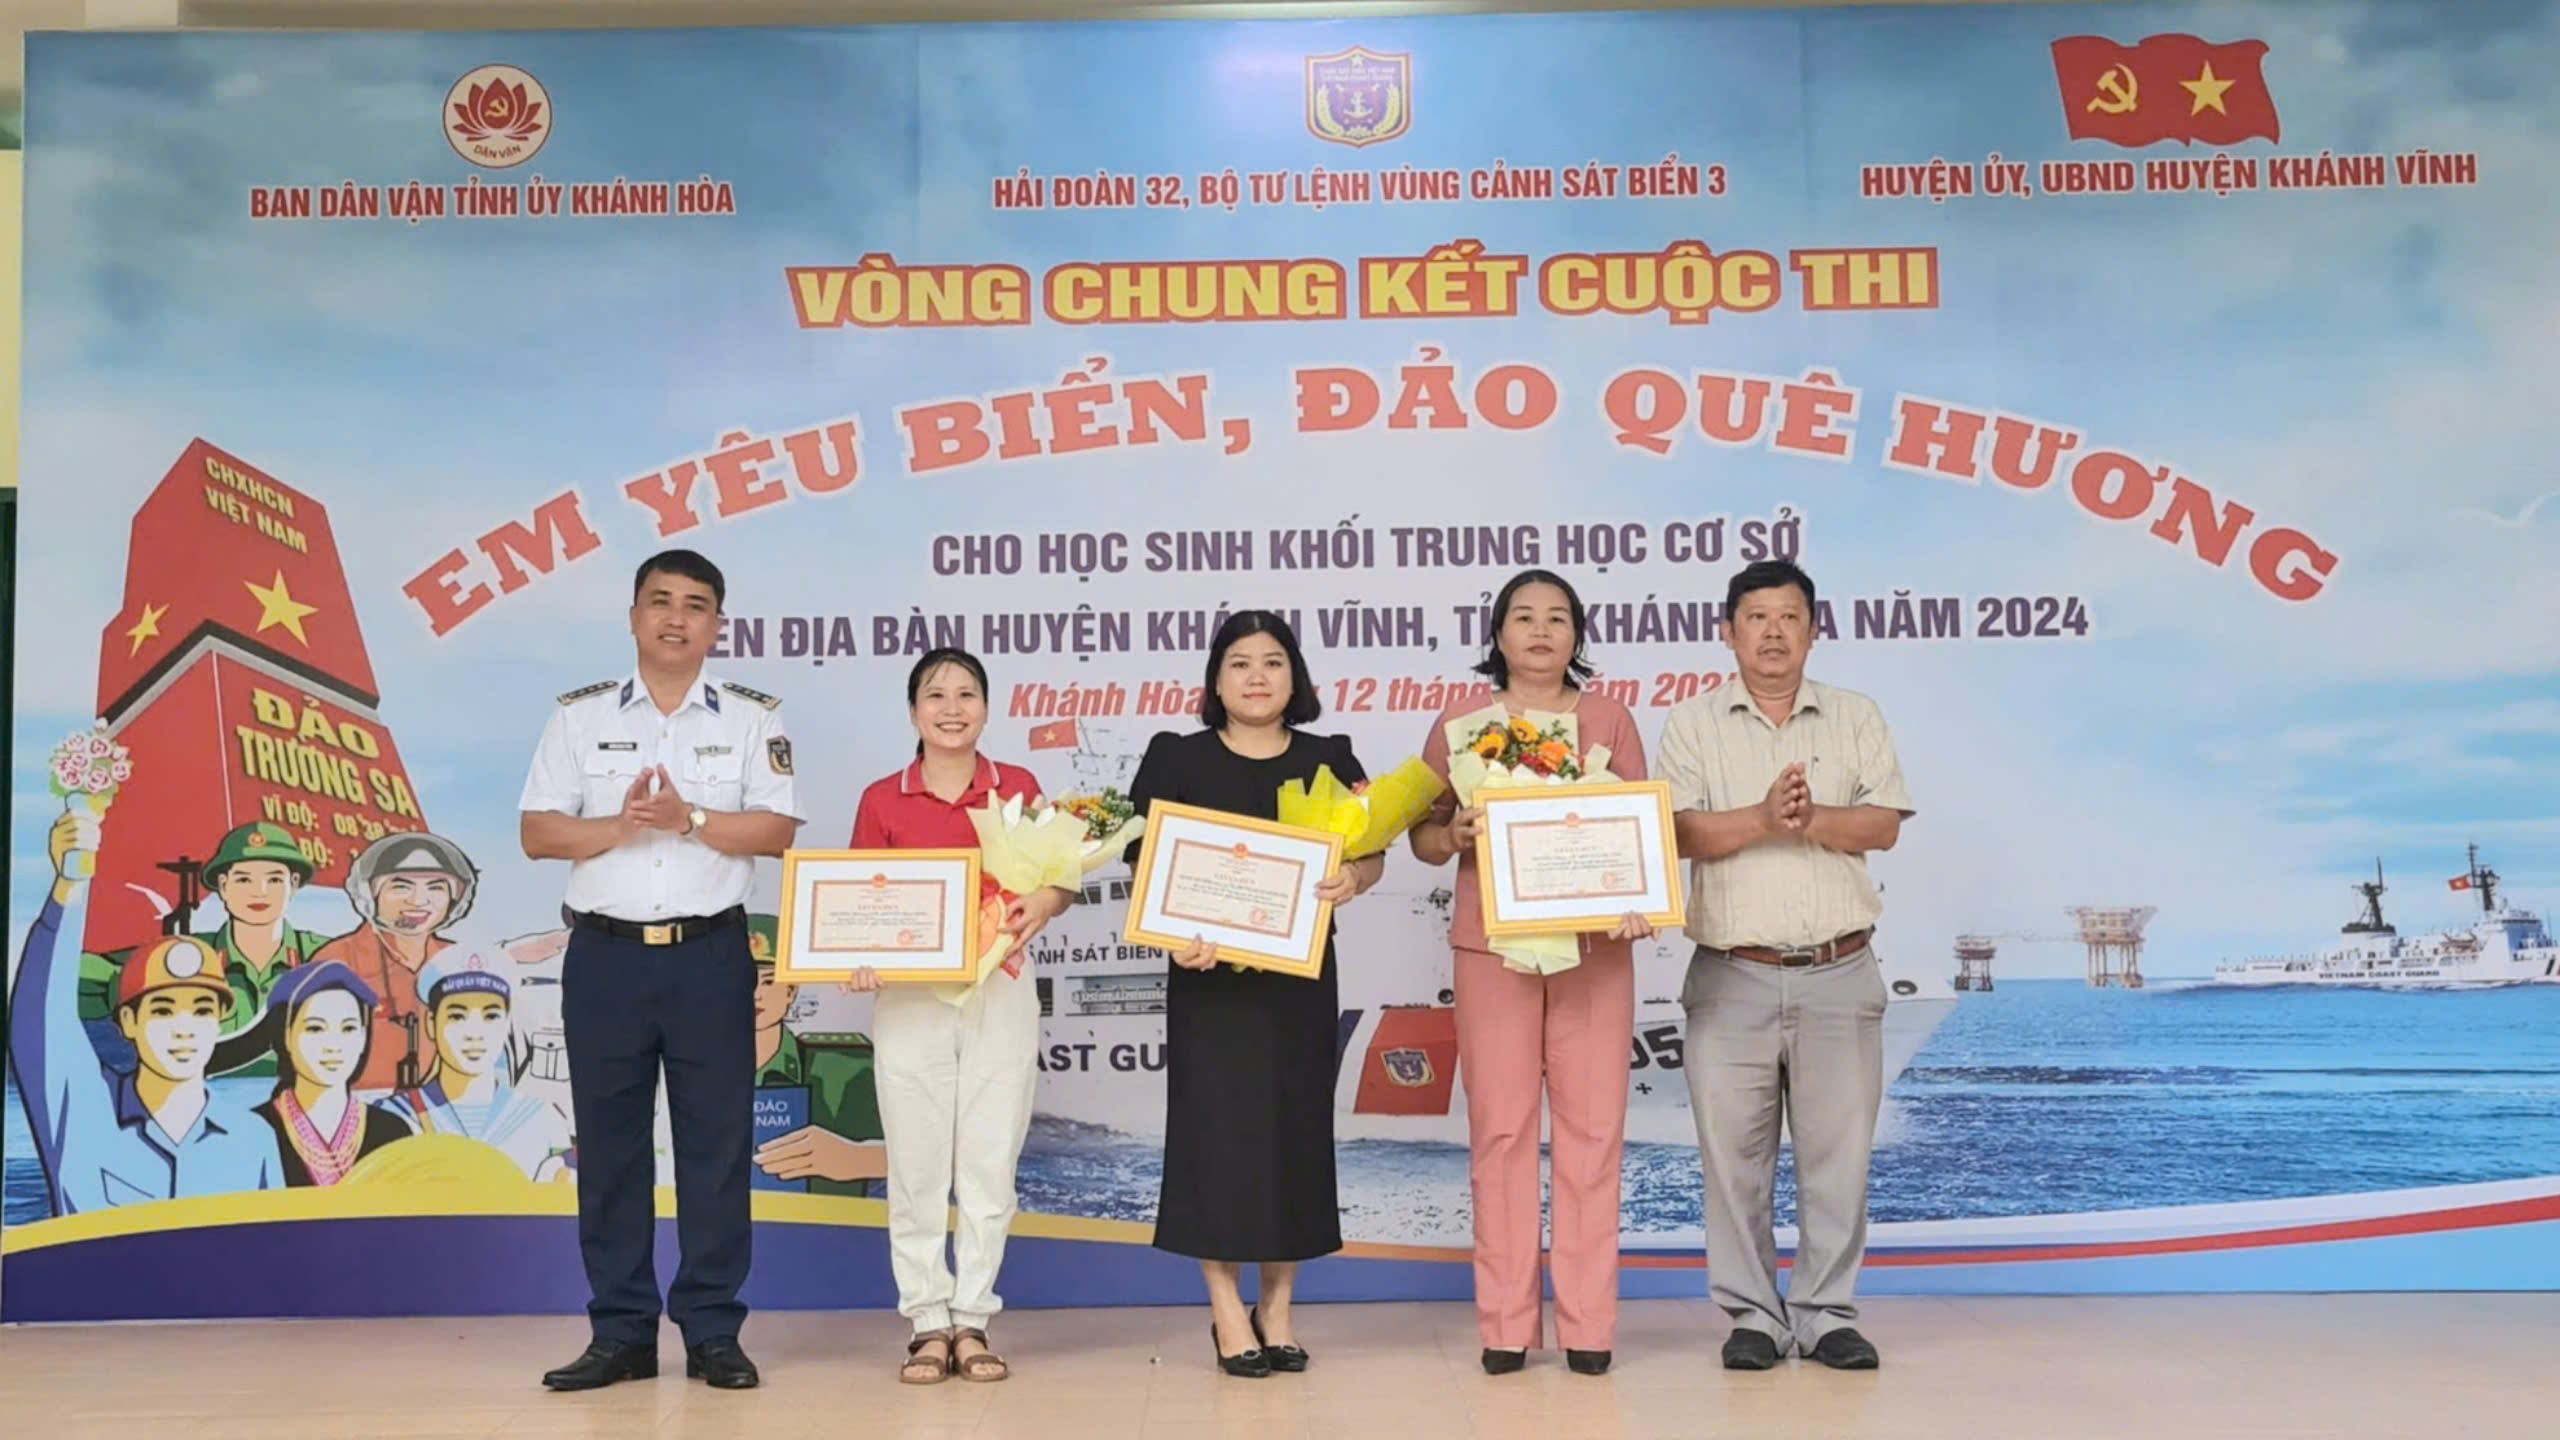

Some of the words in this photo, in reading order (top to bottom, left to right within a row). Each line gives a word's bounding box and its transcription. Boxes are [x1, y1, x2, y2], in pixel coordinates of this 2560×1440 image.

[251, 188, 310, 217] BAN
[320, 181, 379, 217] DÂN
[387, 181, 444, 223] VẬN
[453, 176, 518, 216] TỈNH
[527, 175, 562, 215] ỦY
[571, 178, 668, 215] KHÁNH
[677, 176, 734, 214] HÒA
[994, 168, 1044, 208] HẢI
[1053, 171, 1135, 207] ĐOÀN
[1145, 176, 1190, 208] 32,
[1199, 169, 1239, 211] BỘ
[1249, 171, 1288, 204] TƯ
[1294, 168, 1370, 209] LỆNH
[1380, 165, 1460, 201] VÙNG
[1470, 159, 1553, 199] CẢNH
[1562, 162, 1619, 198] SÁT
[1628, 154, 1698, 196] BIỂN
[1707, 166, 1726, 195] 3
[1862, 160, 1973, 202] HUYỆN
[1983, 154, 2031, 197] ỦY,
[2041, 162, 2135, 194] UBND
[2146, 154, 2257, 196] HUYỆN
[2268, 151, 2385, 189] KHÁNH
[2396, 149, 2477, 185] VĨNH
[794, 256, 1024, 325] VÒNG
[1051, 262, 1340, 321] CHUNG
[1366, 243, 1521, 315] KẾT
[1547, 243, 1773, 321] CUỘC
[1798, 252, 1930, 307] THI
[205, 456, 295, 519] CHXHCN
[402, 489, 602, 637] EM
[624, 421, 860, 538] YÊU
[901, 356, 1251, 473] BIỂN,
[1295, 346, 1558, 433] ĐẢO
[1603, 369, 1855, 456] QUÊ
[1890, 399, 2339, 602] HƯƠNG
[255, 510, 309, 555] NAM
[932, 533, 1023, 576] CHO
[1038, 532, 1129, 583] HỌC
[1145, 530, 1253, 572] SINH
[1269, 513, 1374, 569] KHỐI
[1390, 523, 1541, 568] TRUNG
[1556, 521, 1647, 573] HỌC
[1664, 517, 1725, 563] CƠ
[1740, 506, 1801, 563] SỞ
[780, 616, 858, 666] ĐỊA
[872, 607, 966, 656] BÀN
[983, 603, 1131, 662] HUYỆN
[1319, 600, 1438, 652] VĨNH,
[1854, 589, 1961, 640] NĂM
[1976, 596, 2089, 638] 2024
[252, 687, 381, 759] ĐẢO
[1008, 682, 1123, 718] Khánh
[1334, 677, 1377, 712] 12
[369, 767, 420, 819] SA
[755, 1115, 792, 1128] NAM
